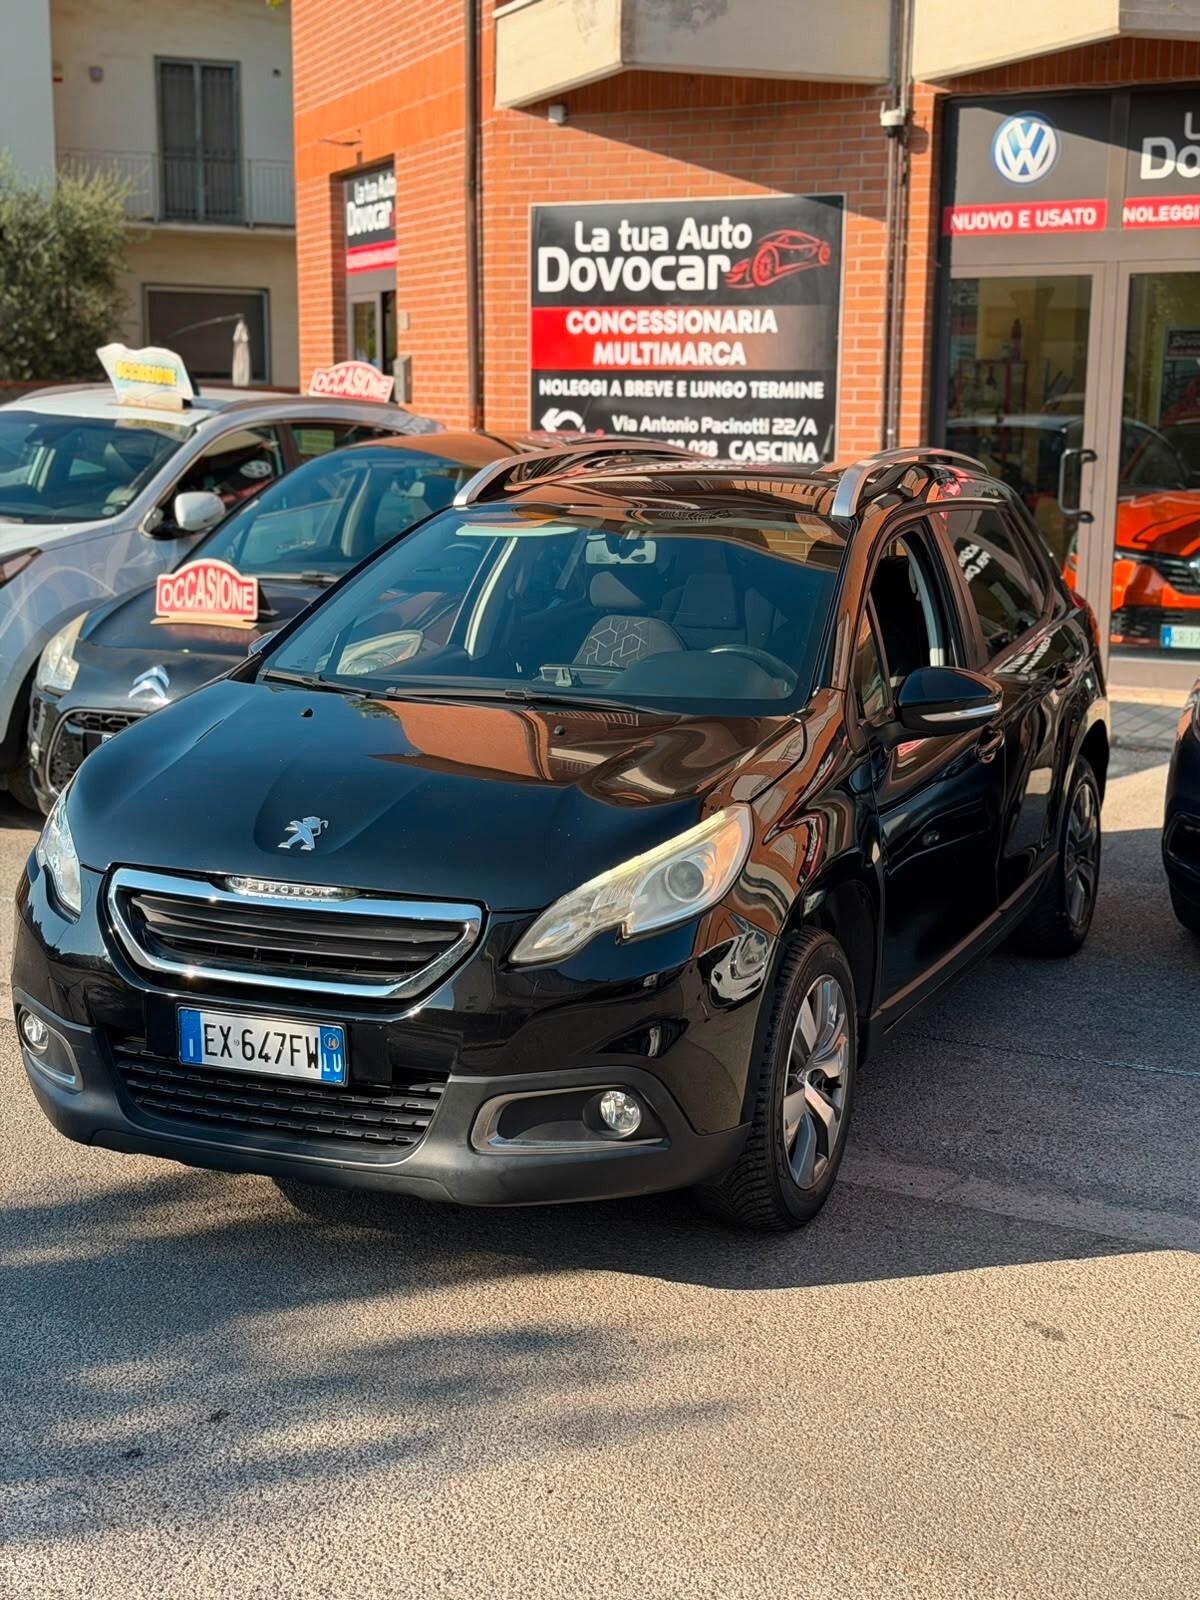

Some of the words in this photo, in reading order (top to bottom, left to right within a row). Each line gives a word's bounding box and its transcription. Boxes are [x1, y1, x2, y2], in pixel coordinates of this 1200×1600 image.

[347, 200, 392, 236] Dovocar
[952, 213, 1013, 231] NUOVO
[1018, 210, 1031, 228] E
[1035, 207, 1096, 226] USATO
[575, 220, 610, 252] La
[618, 219, 669, 251] tua
[676, 216, 753, 250] Auto
[538, 246, 731, 292] Dovocar
[566, 309, 778, 334] CONCESSIONARIA
[593, 341, 747, 366] MULTIMARCA
[314, 366, 390, 399] OCCASIONE
[539, 379, 607, 397] NOLEGGI
[610, 379, 623, 396] A
[624, 380, 673, 398] BREVE
[677, 381, 687, 398] E
[690, 381, 747, 399] LUNGO
[749, 382, 824, 400] TERMINE
[612, 415, 638, 433] Via
[640, 416, 699, 434] Antonio
[701, 416, 770, 436] Pacinotti
[772, 417, 818, 437] 22/A
[728, 441, 819, 463] CASCINA
[161, 568, 254, 610] OCCASIONE
[203, 1023, 233, 1058] EX
[241, 1028, 319, 1070] 647FW
[323, 1052, 342, 1073] LU
